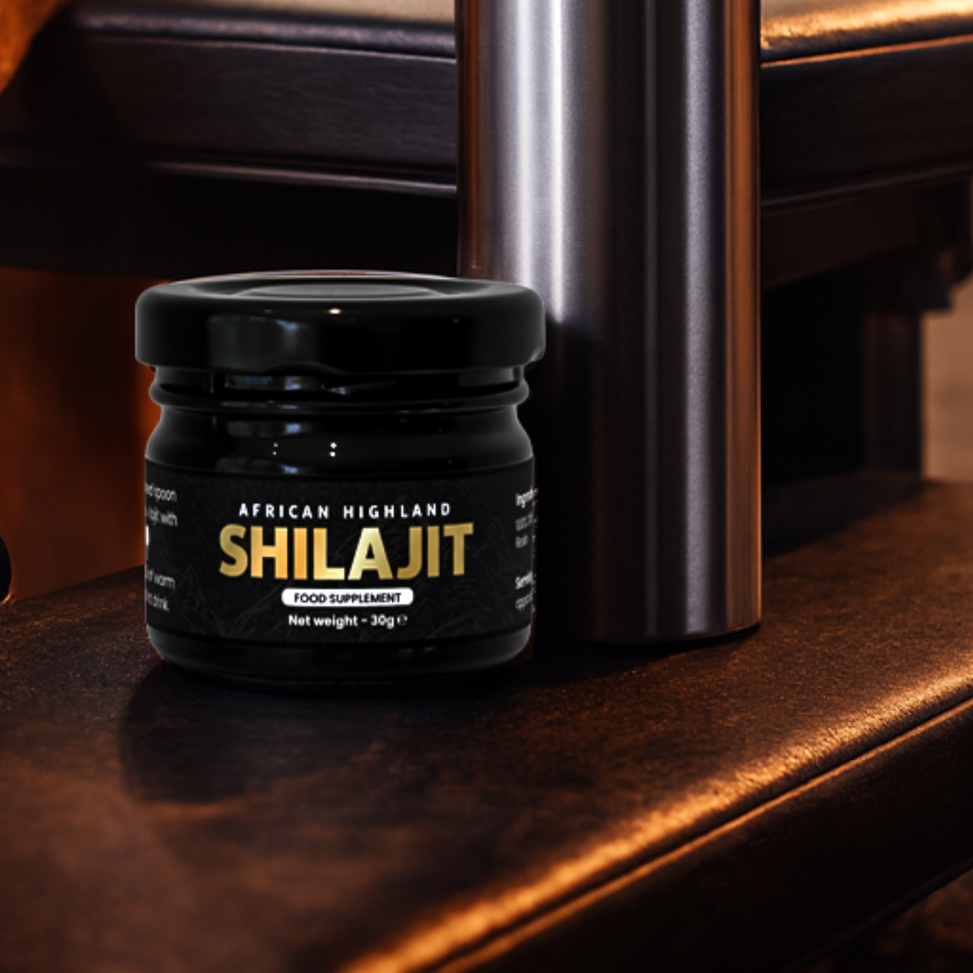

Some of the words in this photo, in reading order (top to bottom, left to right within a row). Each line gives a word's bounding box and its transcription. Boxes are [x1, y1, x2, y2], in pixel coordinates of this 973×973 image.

[239, 503, 329, 519] AFRICAN
[343, 502, 451, 520] HIGHLAND
[219, 522, 474, 580] SHILAJIT
[294, 593, 327, 604] FOOD
[329, 592, 402, 604] SUPPLEMENT
[288, 614, 311, 626] Net
[313, 614, 358, 629] weight
[370, 614, 395, 629] 30g
